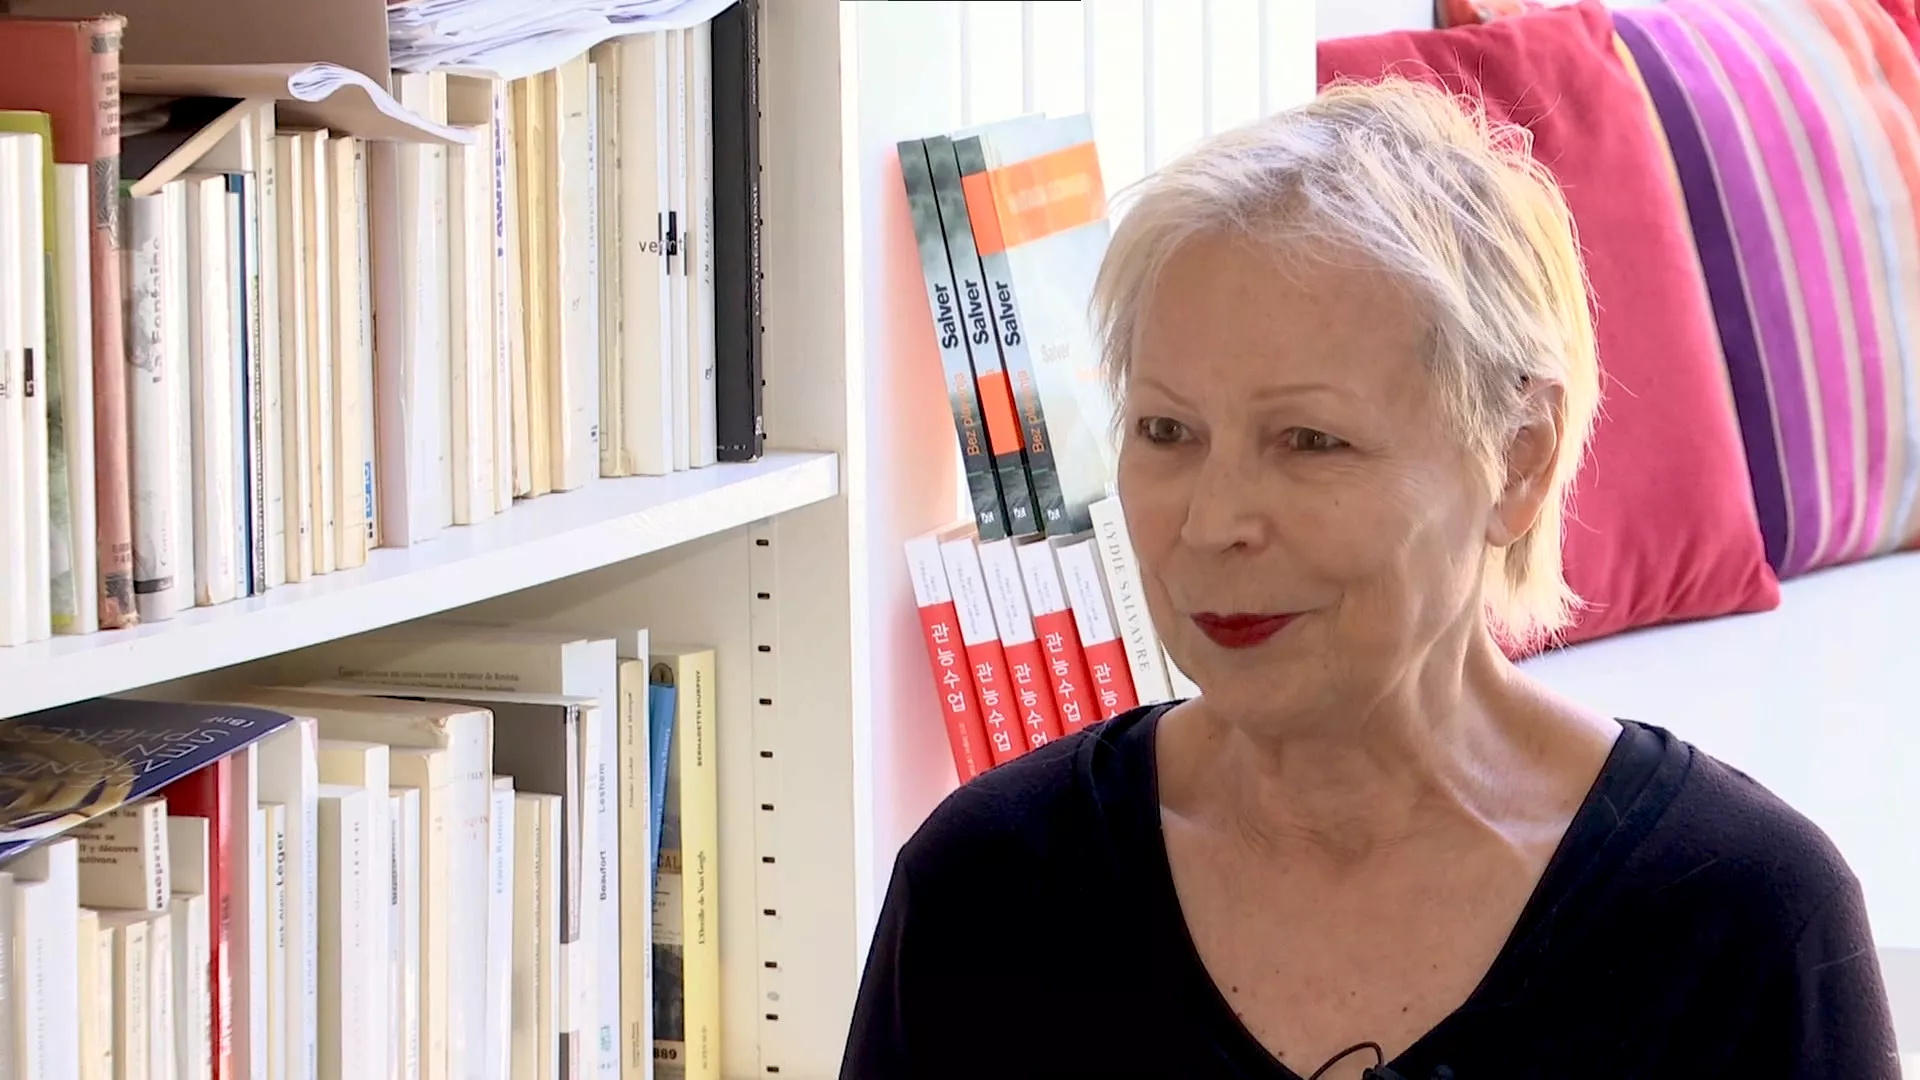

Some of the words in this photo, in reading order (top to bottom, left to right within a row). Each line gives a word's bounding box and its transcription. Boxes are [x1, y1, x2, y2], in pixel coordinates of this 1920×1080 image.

[934, 283, 959, 350] Salver
[965, 279, 990, 345] Salver
[995, 281, 1021, 347] Salver
[965, 431, 981, 456] Bez
[1031, 427, 1045, 453] Bez
[1103, 520, 1125, 575] LYDIE
[1120, 581, 1151, 672] SALVAYRE
[931, 622, 967, 713] 관능수업
[1045, 631, 1081, 723] 관능수업
[975, 661, 1012, 753] 관능수업
[0, 758, 170, 773] MOND
[118, 743, 199, 758] EN
[598, 763, 606, 814] Leshem
[275, 831, 286, 886] Léger
[599, 850, 607, 901] Beaufort
